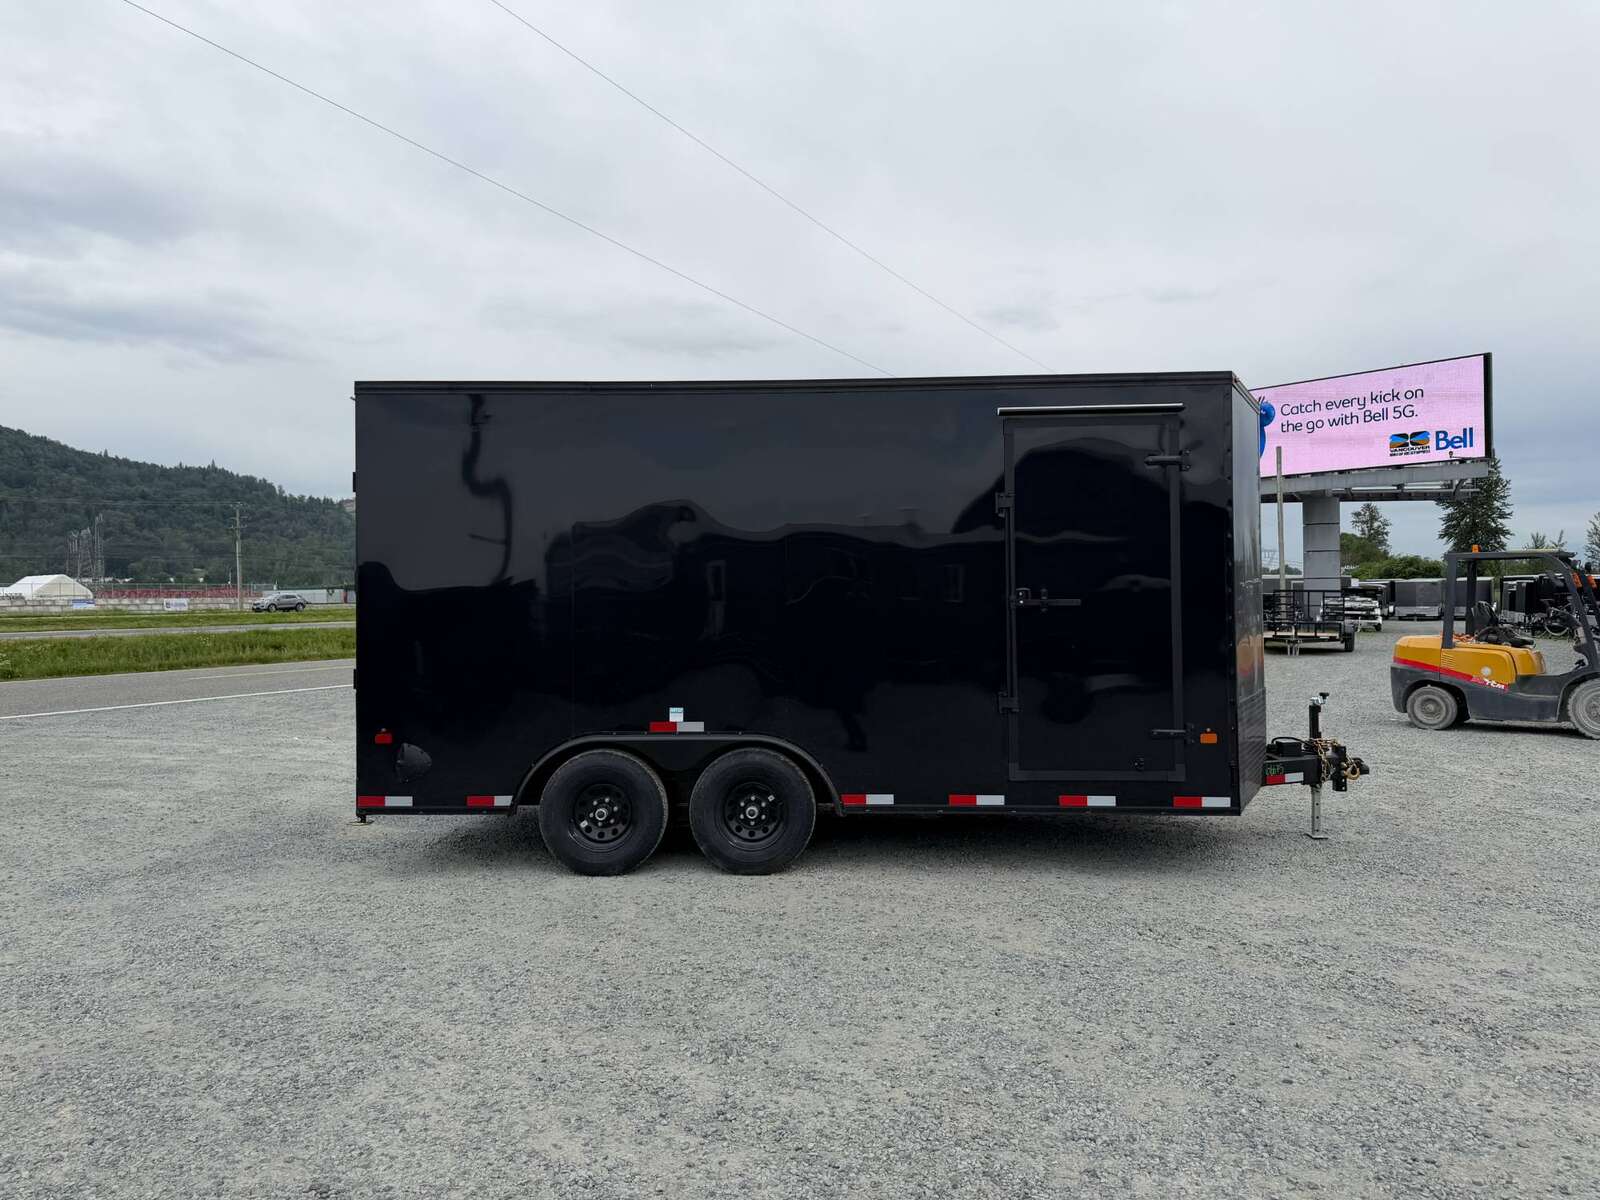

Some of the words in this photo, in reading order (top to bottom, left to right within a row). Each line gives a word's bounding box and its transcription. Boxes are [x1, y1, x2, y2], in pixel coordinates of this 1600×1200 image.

[1280, 399, 1321, 416] Catch
[1325, 396, 1366, 410] every
[1370, 388, 1400, 405] kick
[1404, 388, 1424, 400] on
[1281, 420, 1303, 433] the
[1306, 419, 1325, 433] go
[1328, 411, 1359, 428] with
[1363, 408, 1389, 423] Bell
[1393, 404, 1418, 420] 5G.
[1435, 427, 1474, 451] Bell
